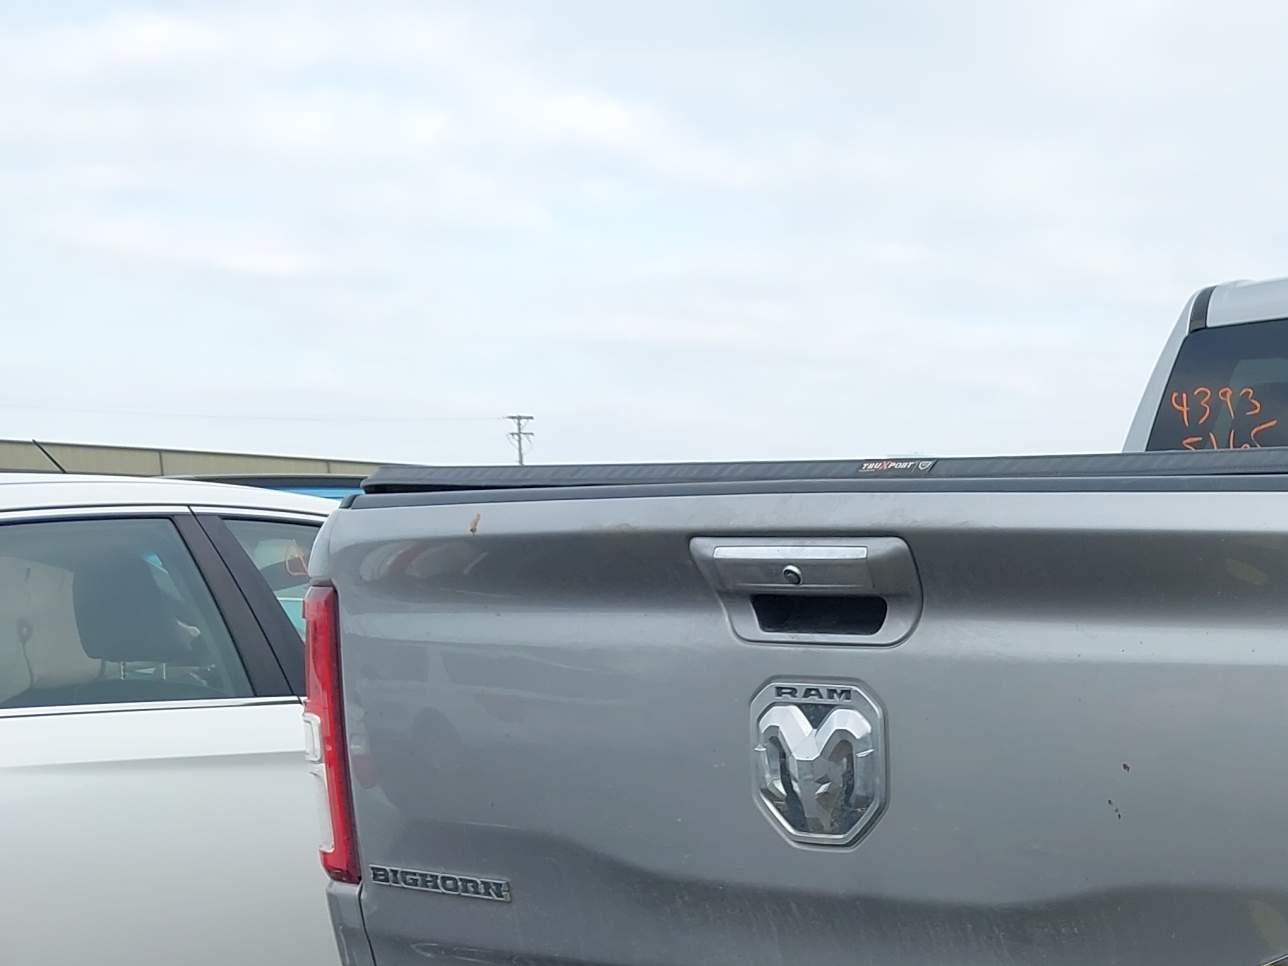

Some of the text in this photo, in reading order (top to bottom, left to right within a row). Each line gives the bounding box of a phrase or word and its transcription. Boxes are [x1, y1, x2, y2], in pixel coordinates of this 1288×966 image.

[1171, 387, 1262, 427] 4393
[774, 686, 852, 701] RAM
[369, 864, 512, 903] BIGHORN
